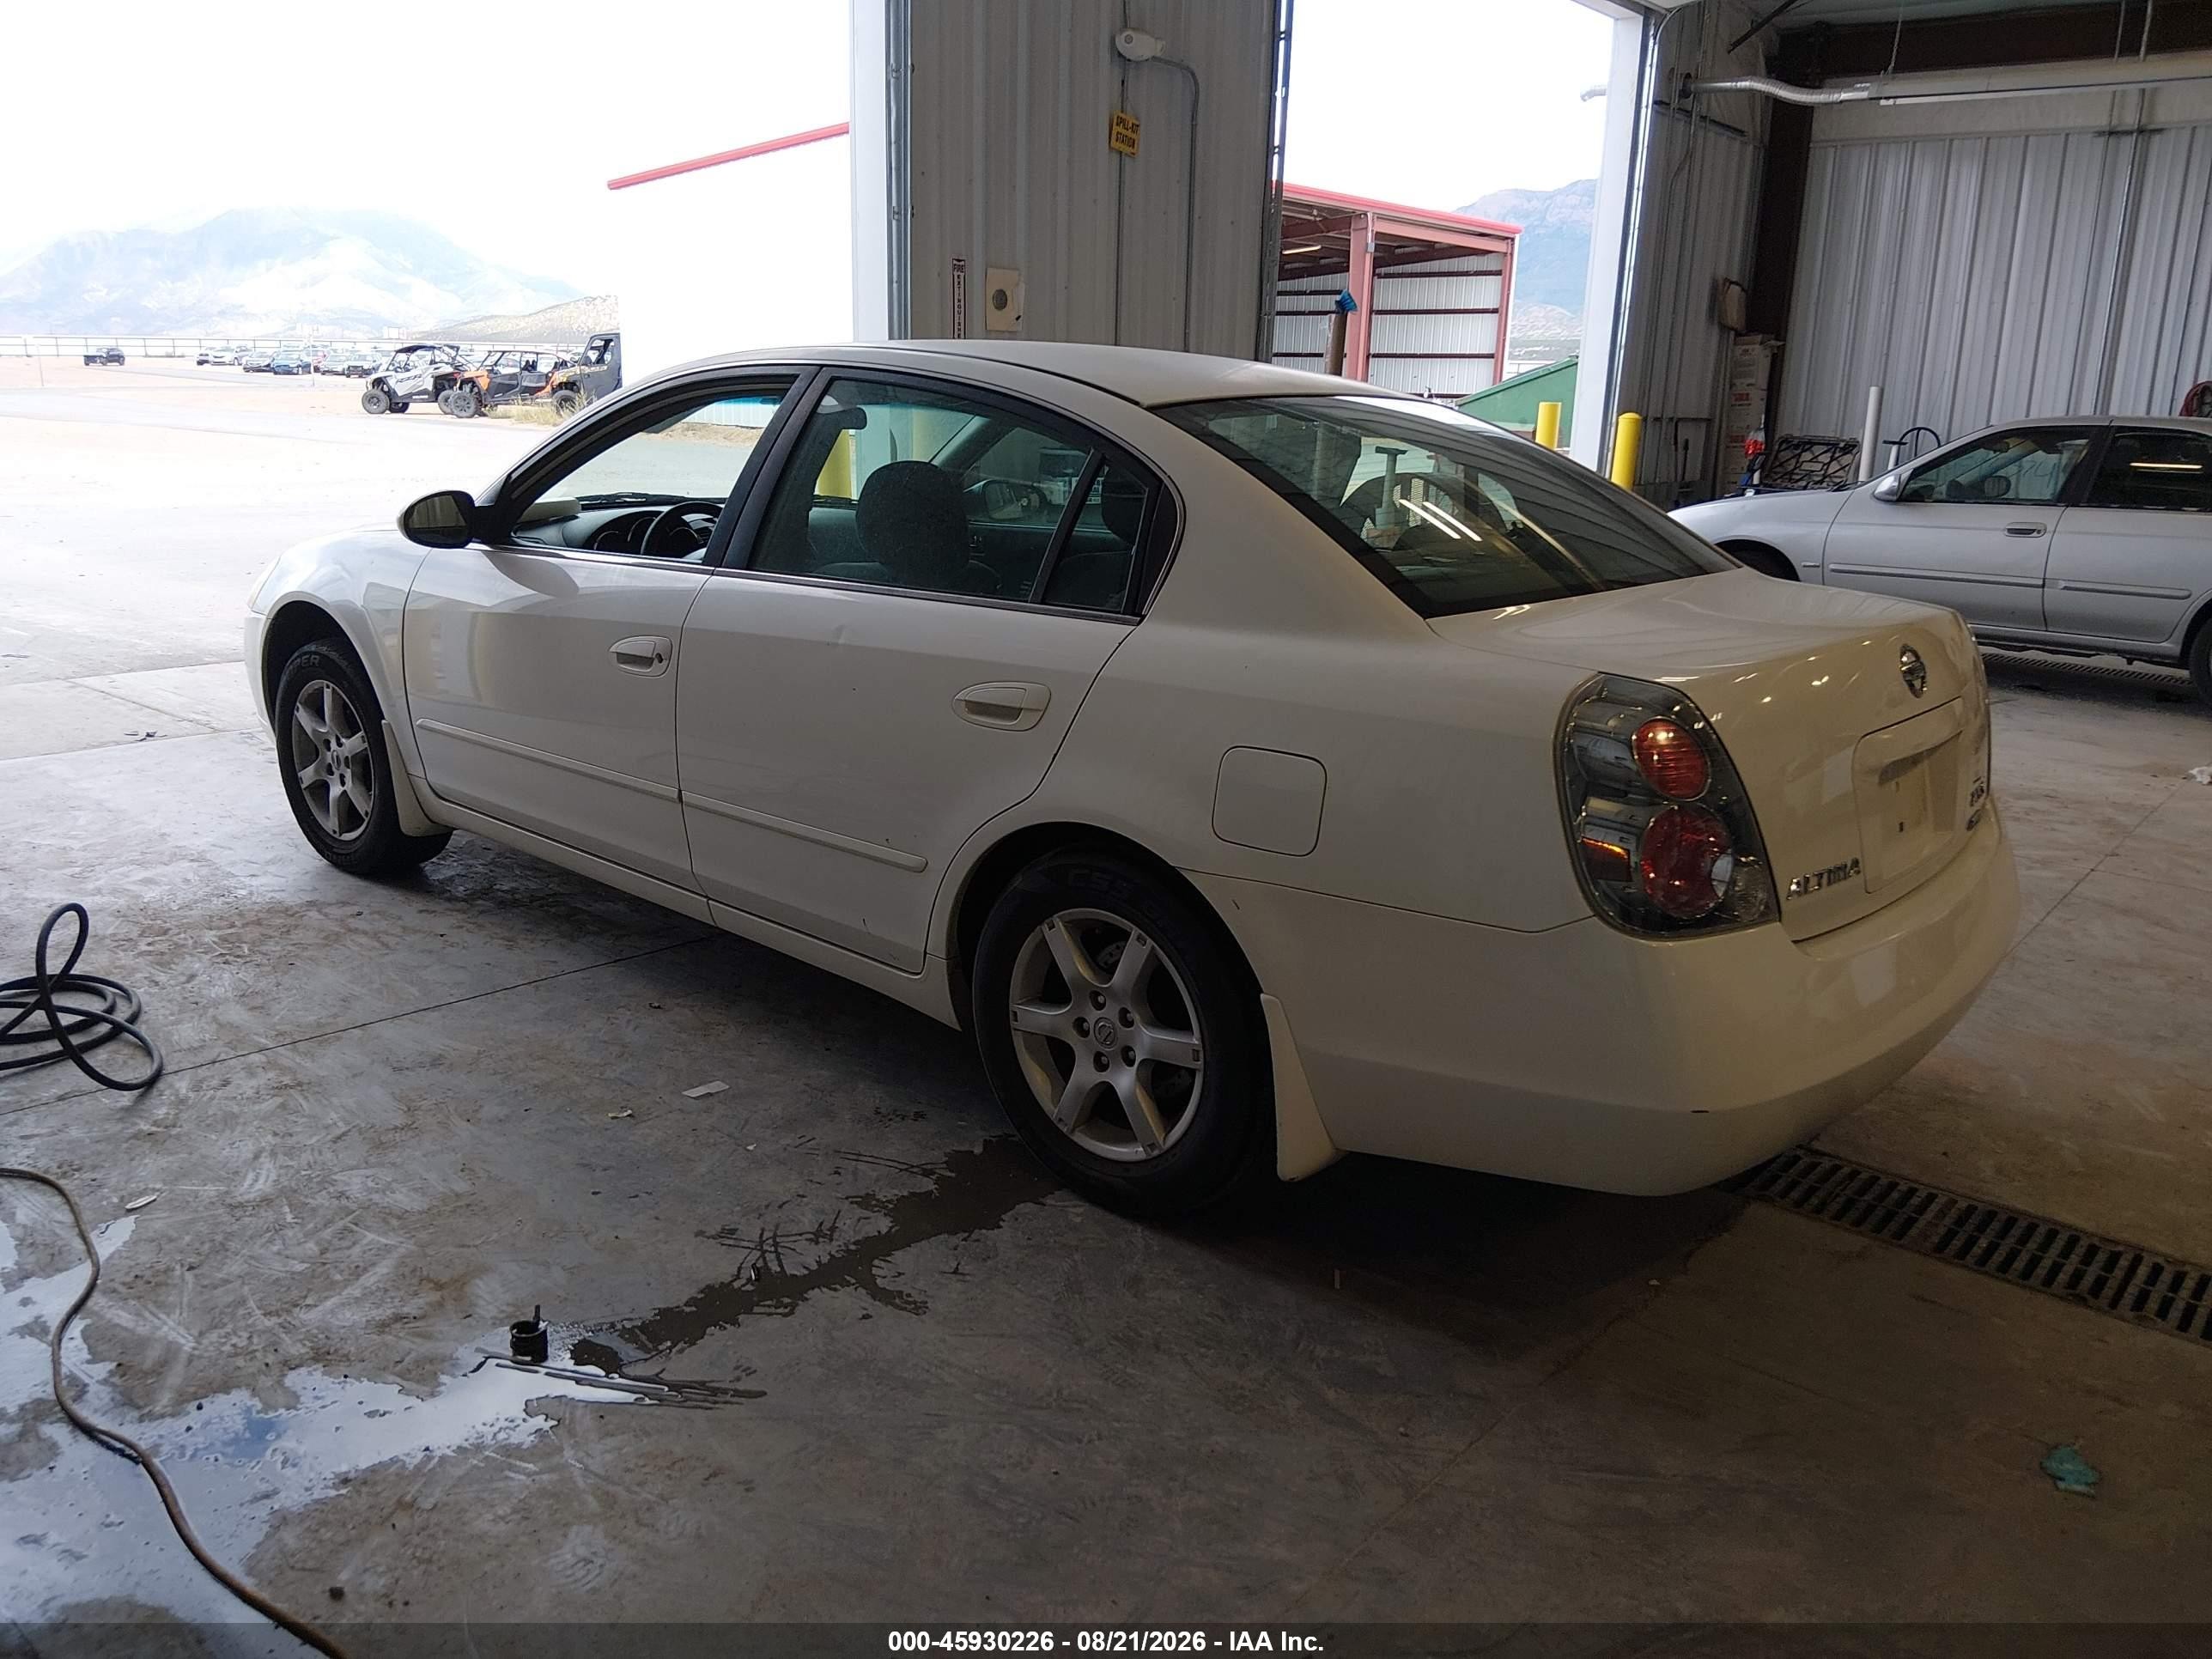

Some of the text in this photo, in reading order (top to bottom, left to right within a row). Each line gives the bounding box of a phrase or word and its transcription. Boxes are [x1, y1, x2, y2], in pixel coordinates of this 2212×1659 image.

[1116, 115, 1140, 135] SPILL-KIT
[1115, 131, 1136, 149] STATION
[953, 264, 964, 273] FIRE
[1786, 857, 1861, 900] ALTIMA
